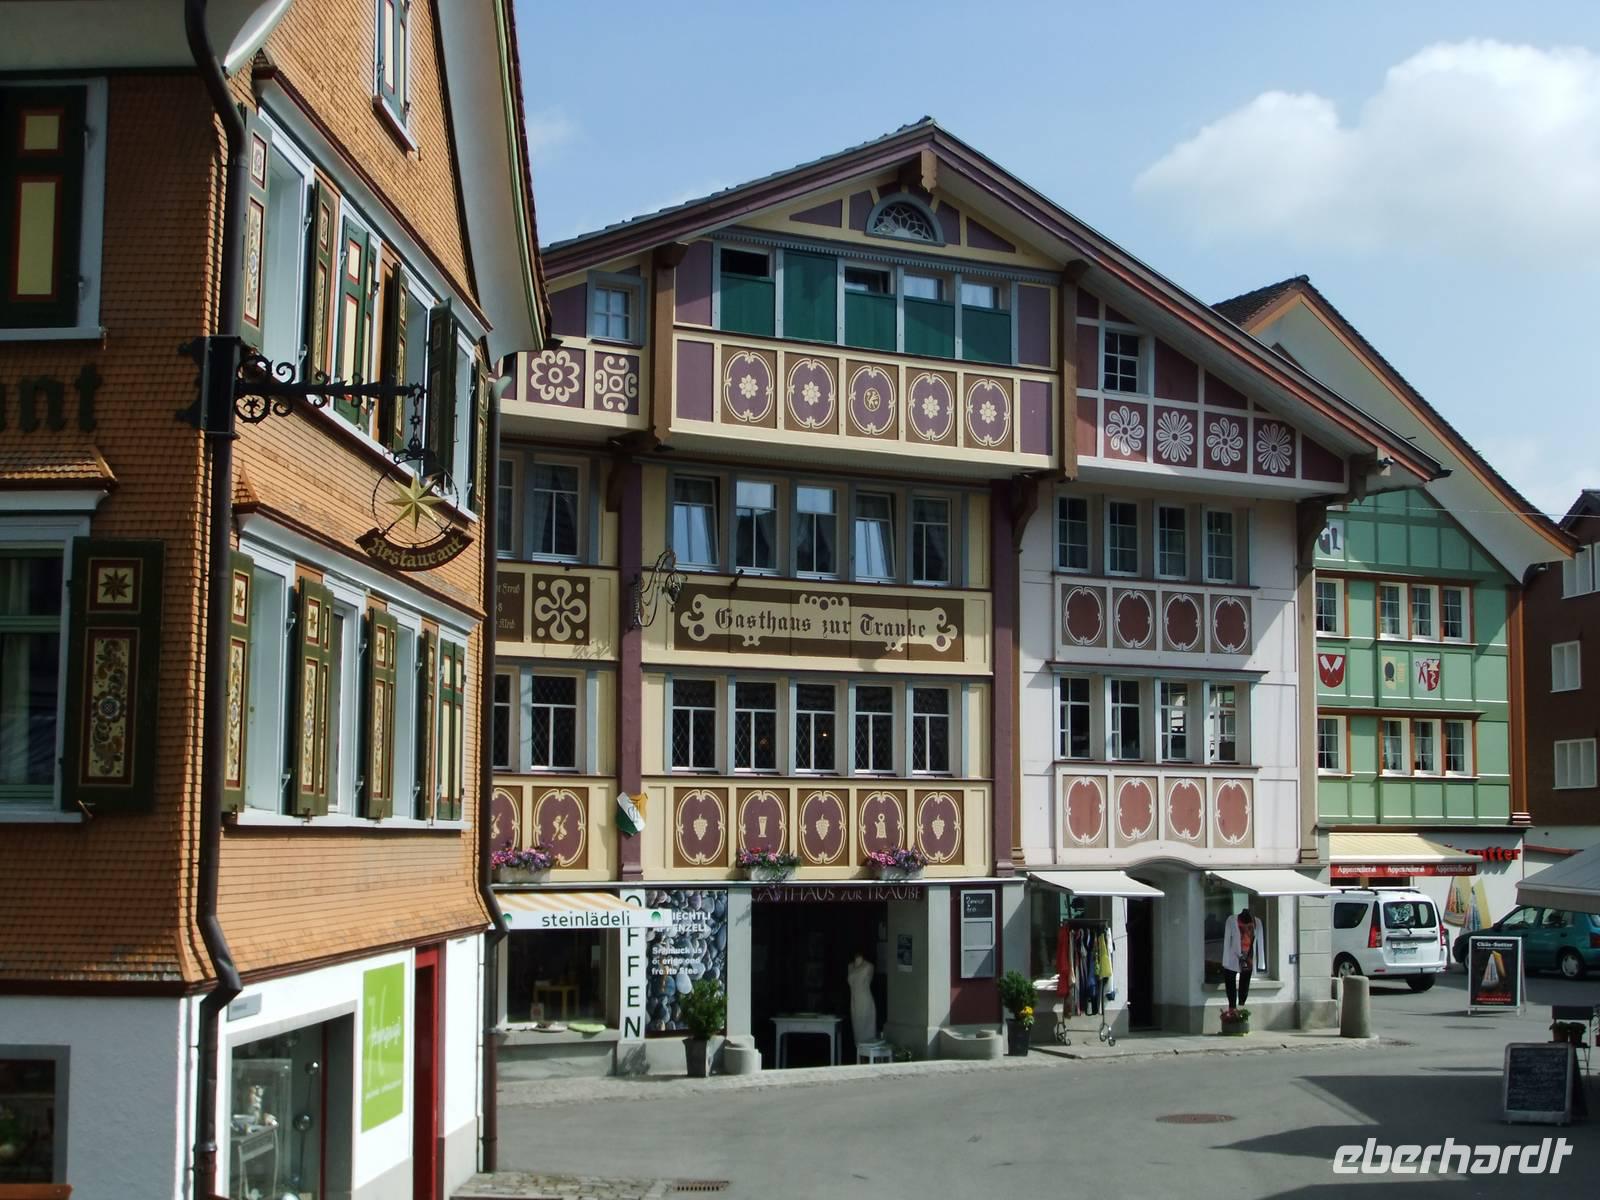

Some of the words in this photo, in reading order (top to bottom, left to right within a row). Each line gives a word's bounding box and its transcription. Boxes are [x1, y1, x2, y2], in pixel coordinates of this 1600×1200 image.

[0, 363, 103, 433] nt
[366, 535, 463, 567] Restaurant
[714, 606, 812, 636] Gasthaus
[822, 616, 851, 638] zur
[859, 613, 927, 639] Traube
[541, 910, 631, 928] steinlädeli
[672, 911, 711, 920] IECHTLI
